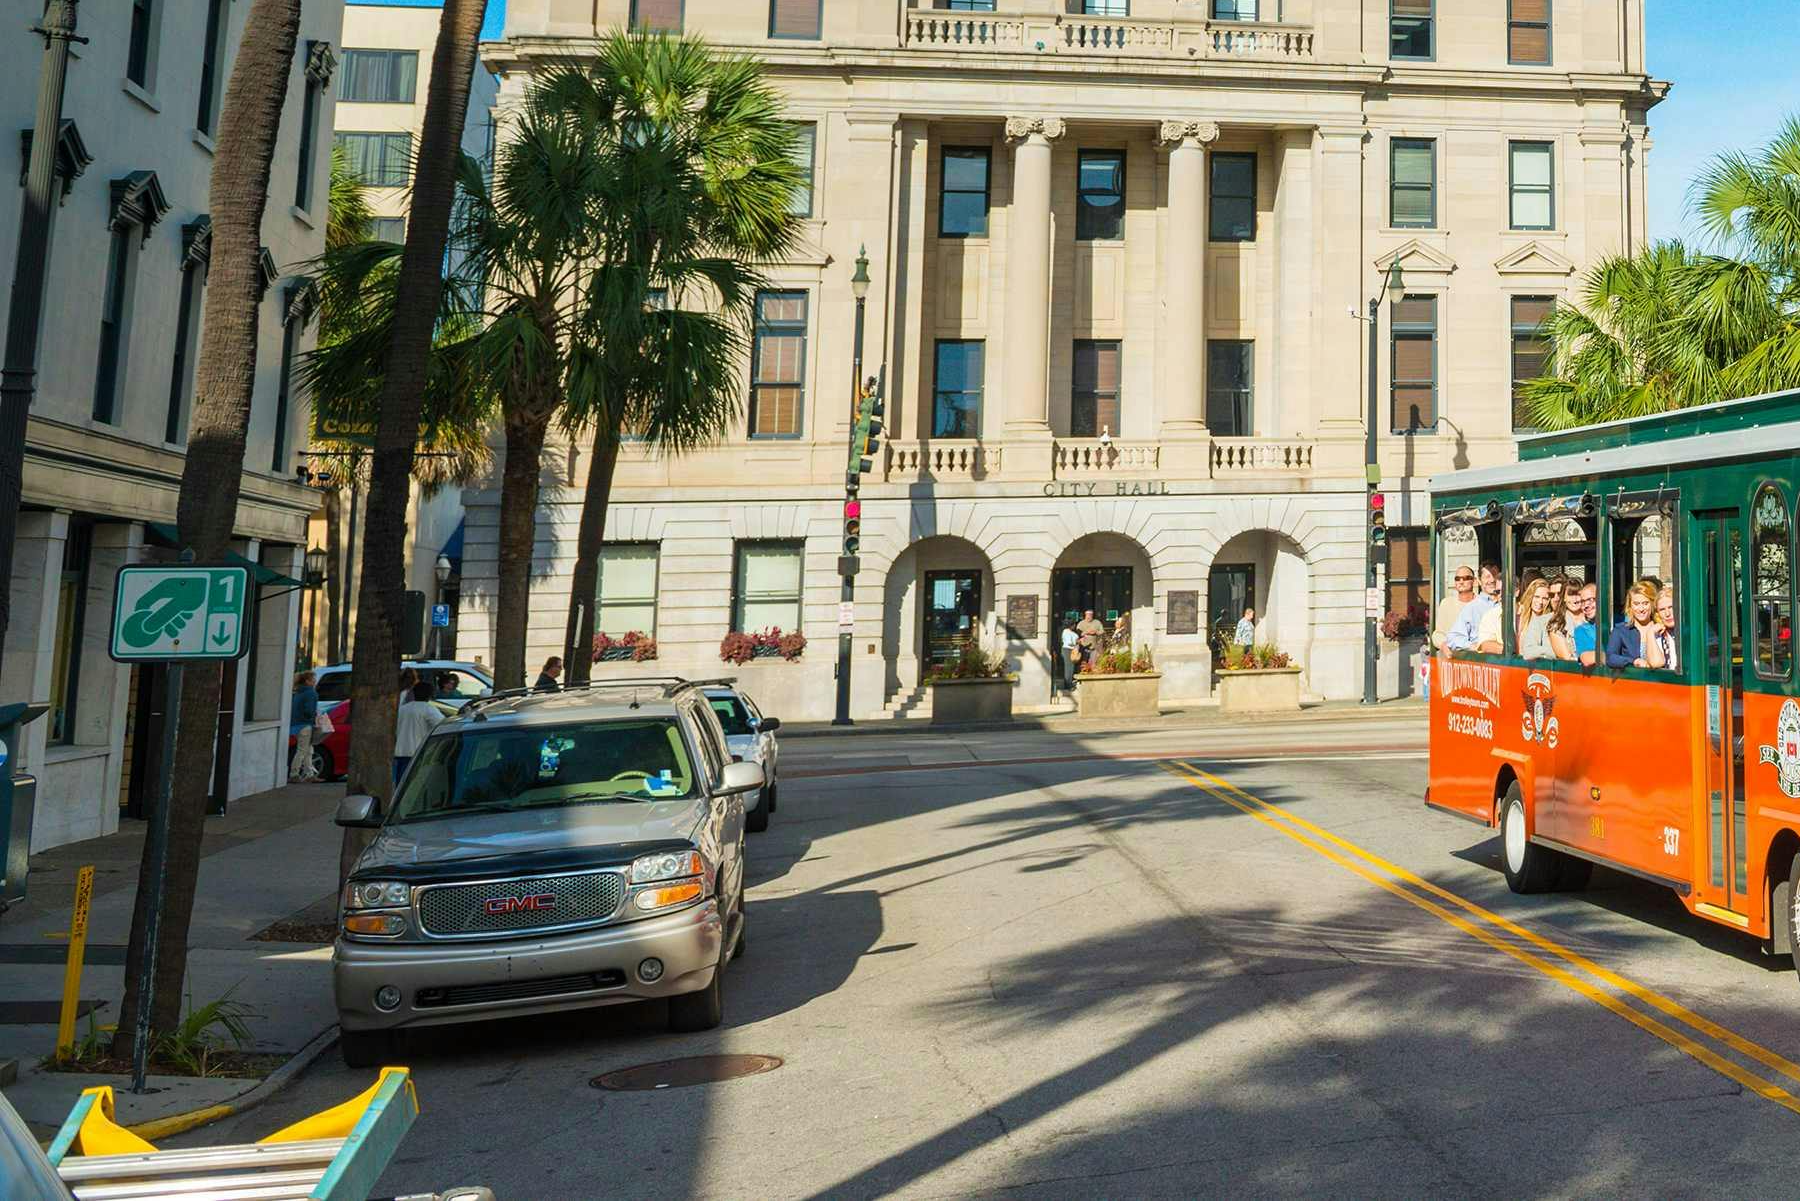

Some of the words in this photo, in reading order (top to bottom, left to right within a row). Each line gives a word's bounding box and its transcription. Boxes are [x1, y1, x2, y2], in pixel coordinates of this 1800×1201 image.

[1043, 482, 1097, 497] CITY
[1116, 481, 1170, 496] HALL
[219, 575, 235, 603] 1
[1440, 661, 1454, 698] OLD
[1453, 663, 1473, 690] TOWN
[1473, 665, 1501, 709] TROLLEY
[1761, 747, 1775, 761] SEE
[1663, 826, 1680, 856] 337
[483, 892, 557, 915] GMC
